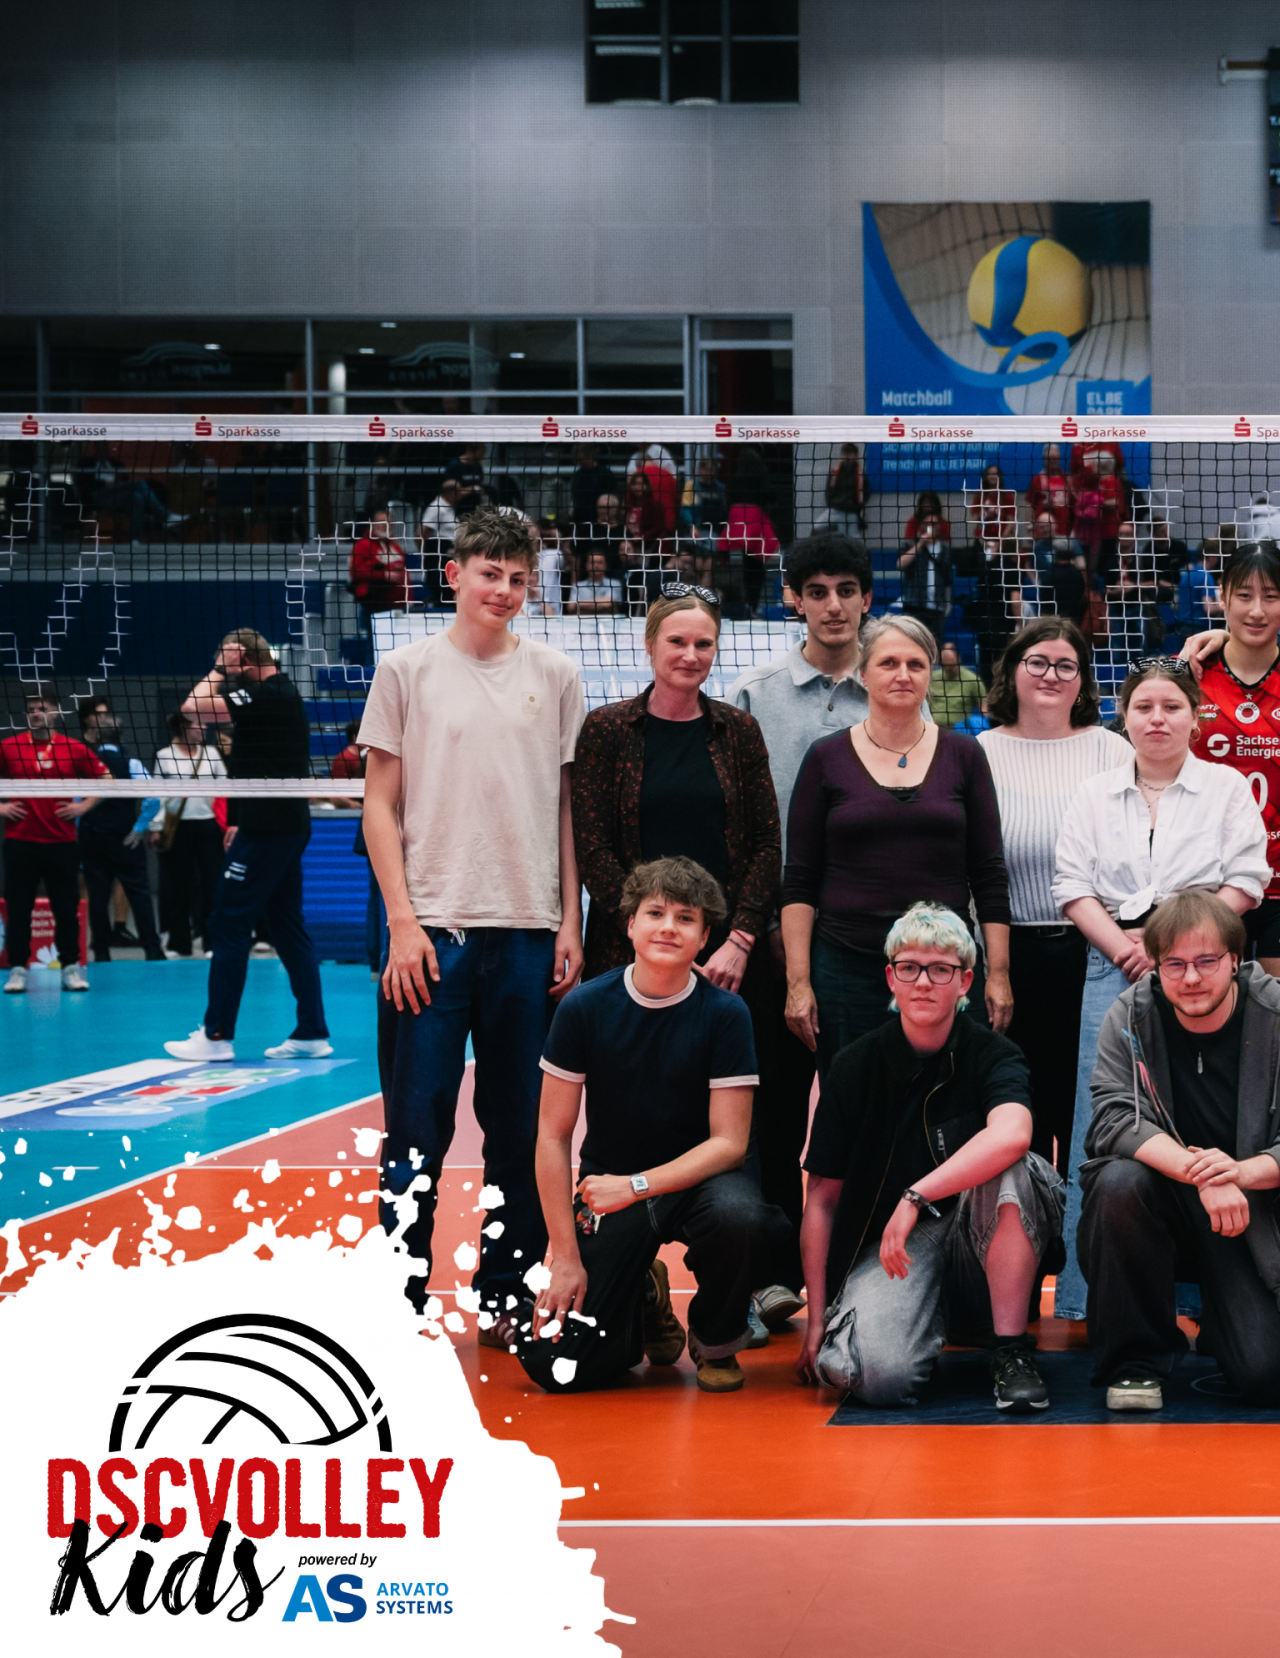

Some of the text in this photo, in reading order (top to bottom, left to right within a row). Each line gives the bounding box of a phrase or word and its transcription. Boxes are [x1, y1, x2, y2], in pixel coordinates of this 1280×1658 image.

[882, 389, 952, 407] Matchball
[1086, 391, 1123, 406] ELBE
[44, 425, 107, 439] Sparkasse
[218, 426, 281, 439] Sparkasse
[391, 426, 454, 440] Sparkasse
[564, 427, 627, 440] Sparkasse
[737, 427, 800, 440] Sparkasse
[911, 427, 973, 440] Sparkasse
[1083, 426, 1146, 440] Sparkasse
[1248, 772, 1268, 813] 0
